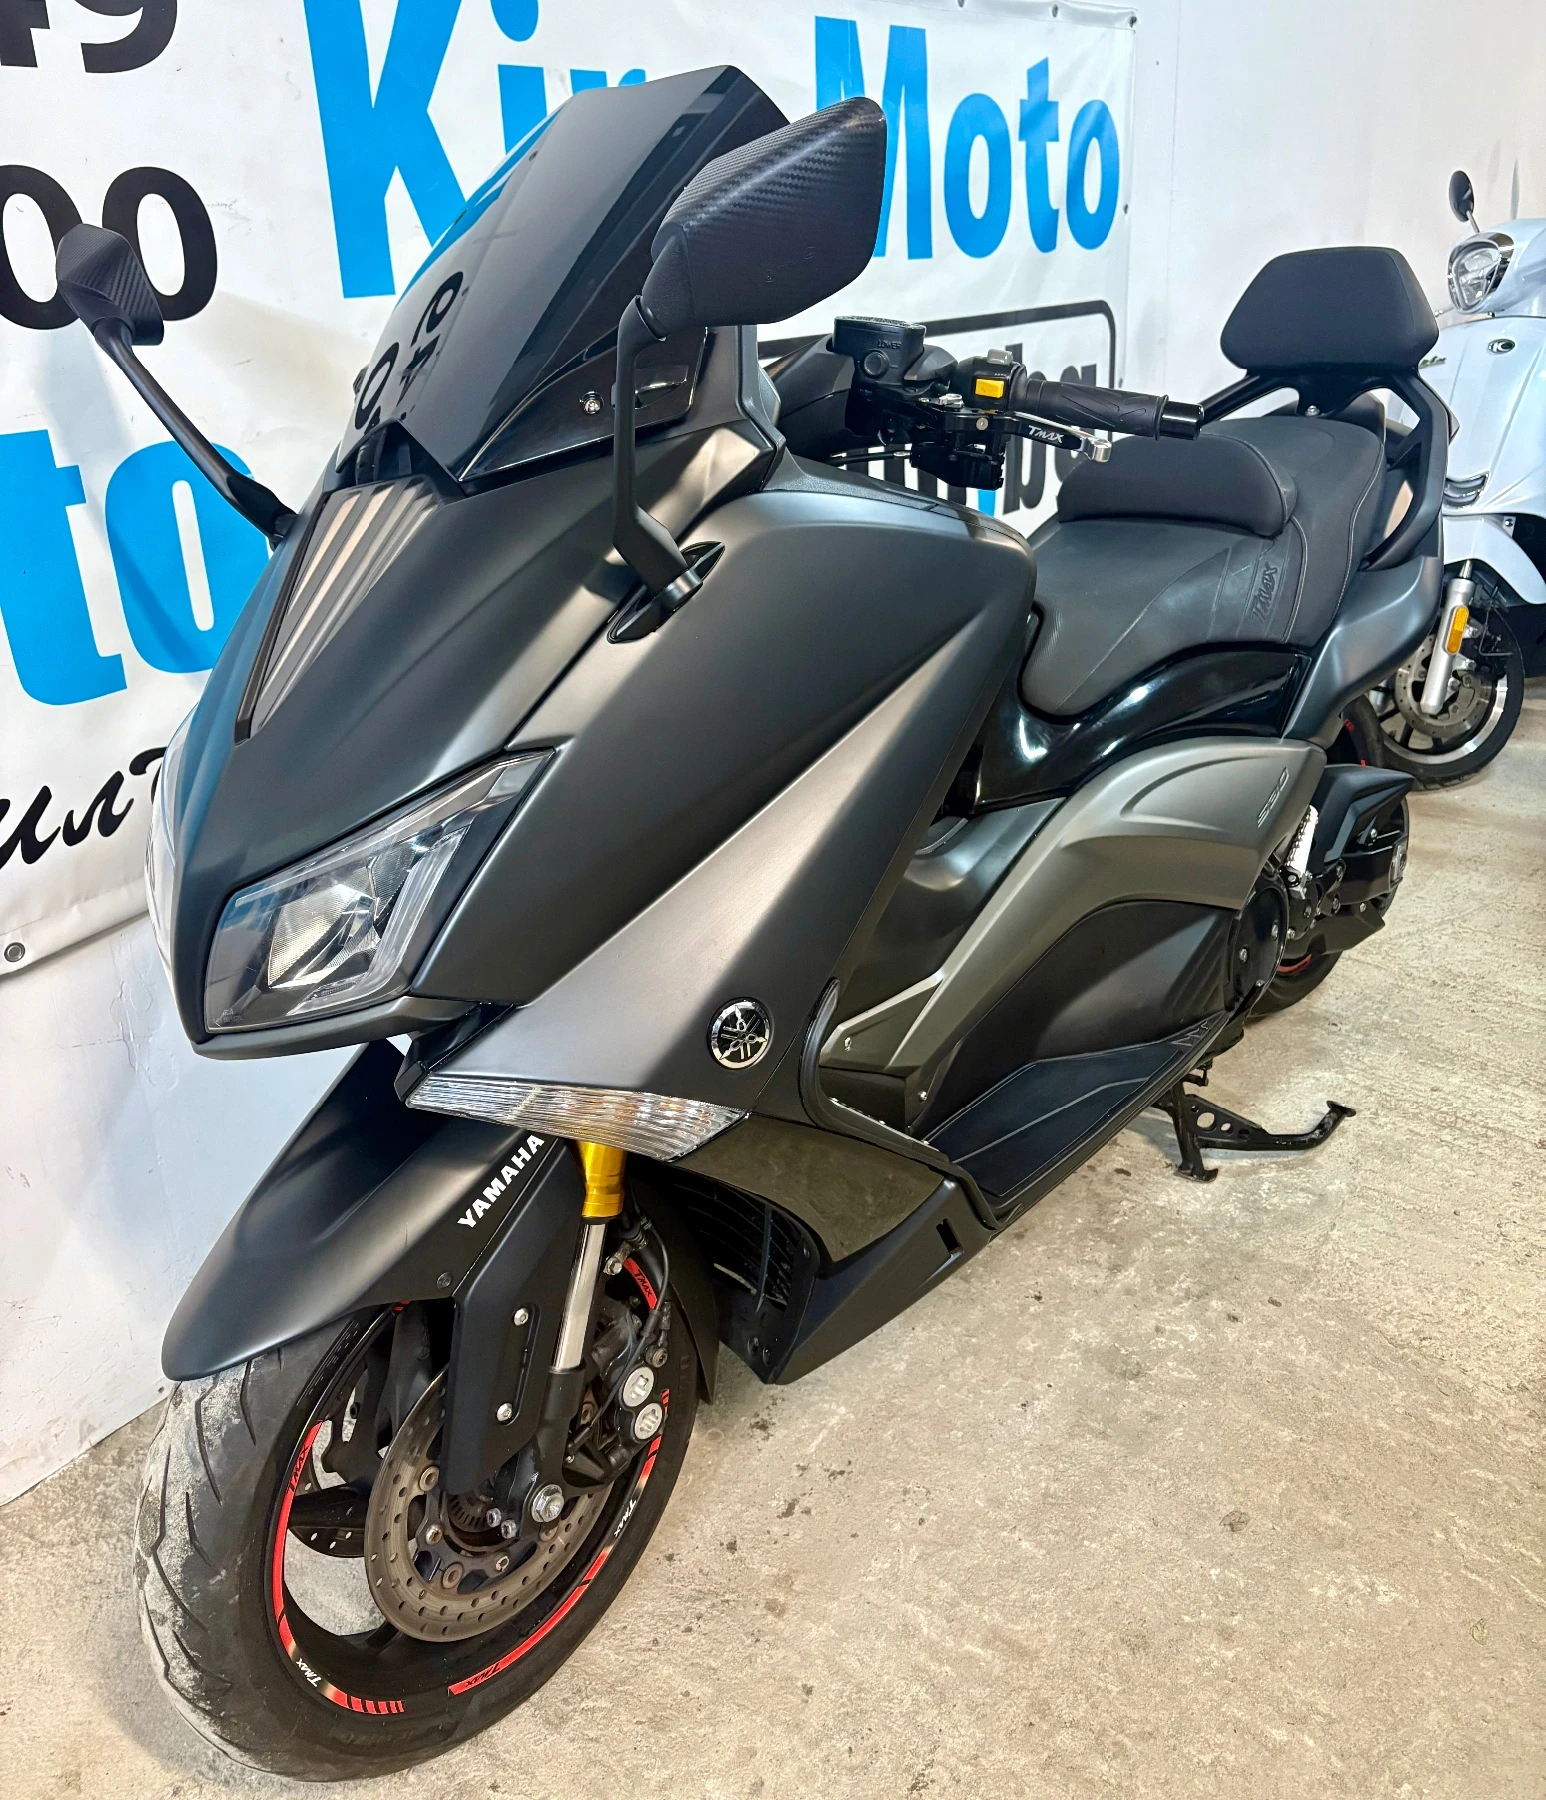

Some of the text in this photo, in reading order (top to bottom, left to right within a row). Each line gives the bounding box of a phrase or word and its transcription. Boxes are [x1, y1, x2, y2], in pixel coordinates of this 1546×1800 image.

[815, 16, 1120, 260] Moto
[1028, 424, 1065, 444] TMAX
[457, 1134, 545, 1228] YAMAHA
[296, 1657, 322, 1688] TMAX
